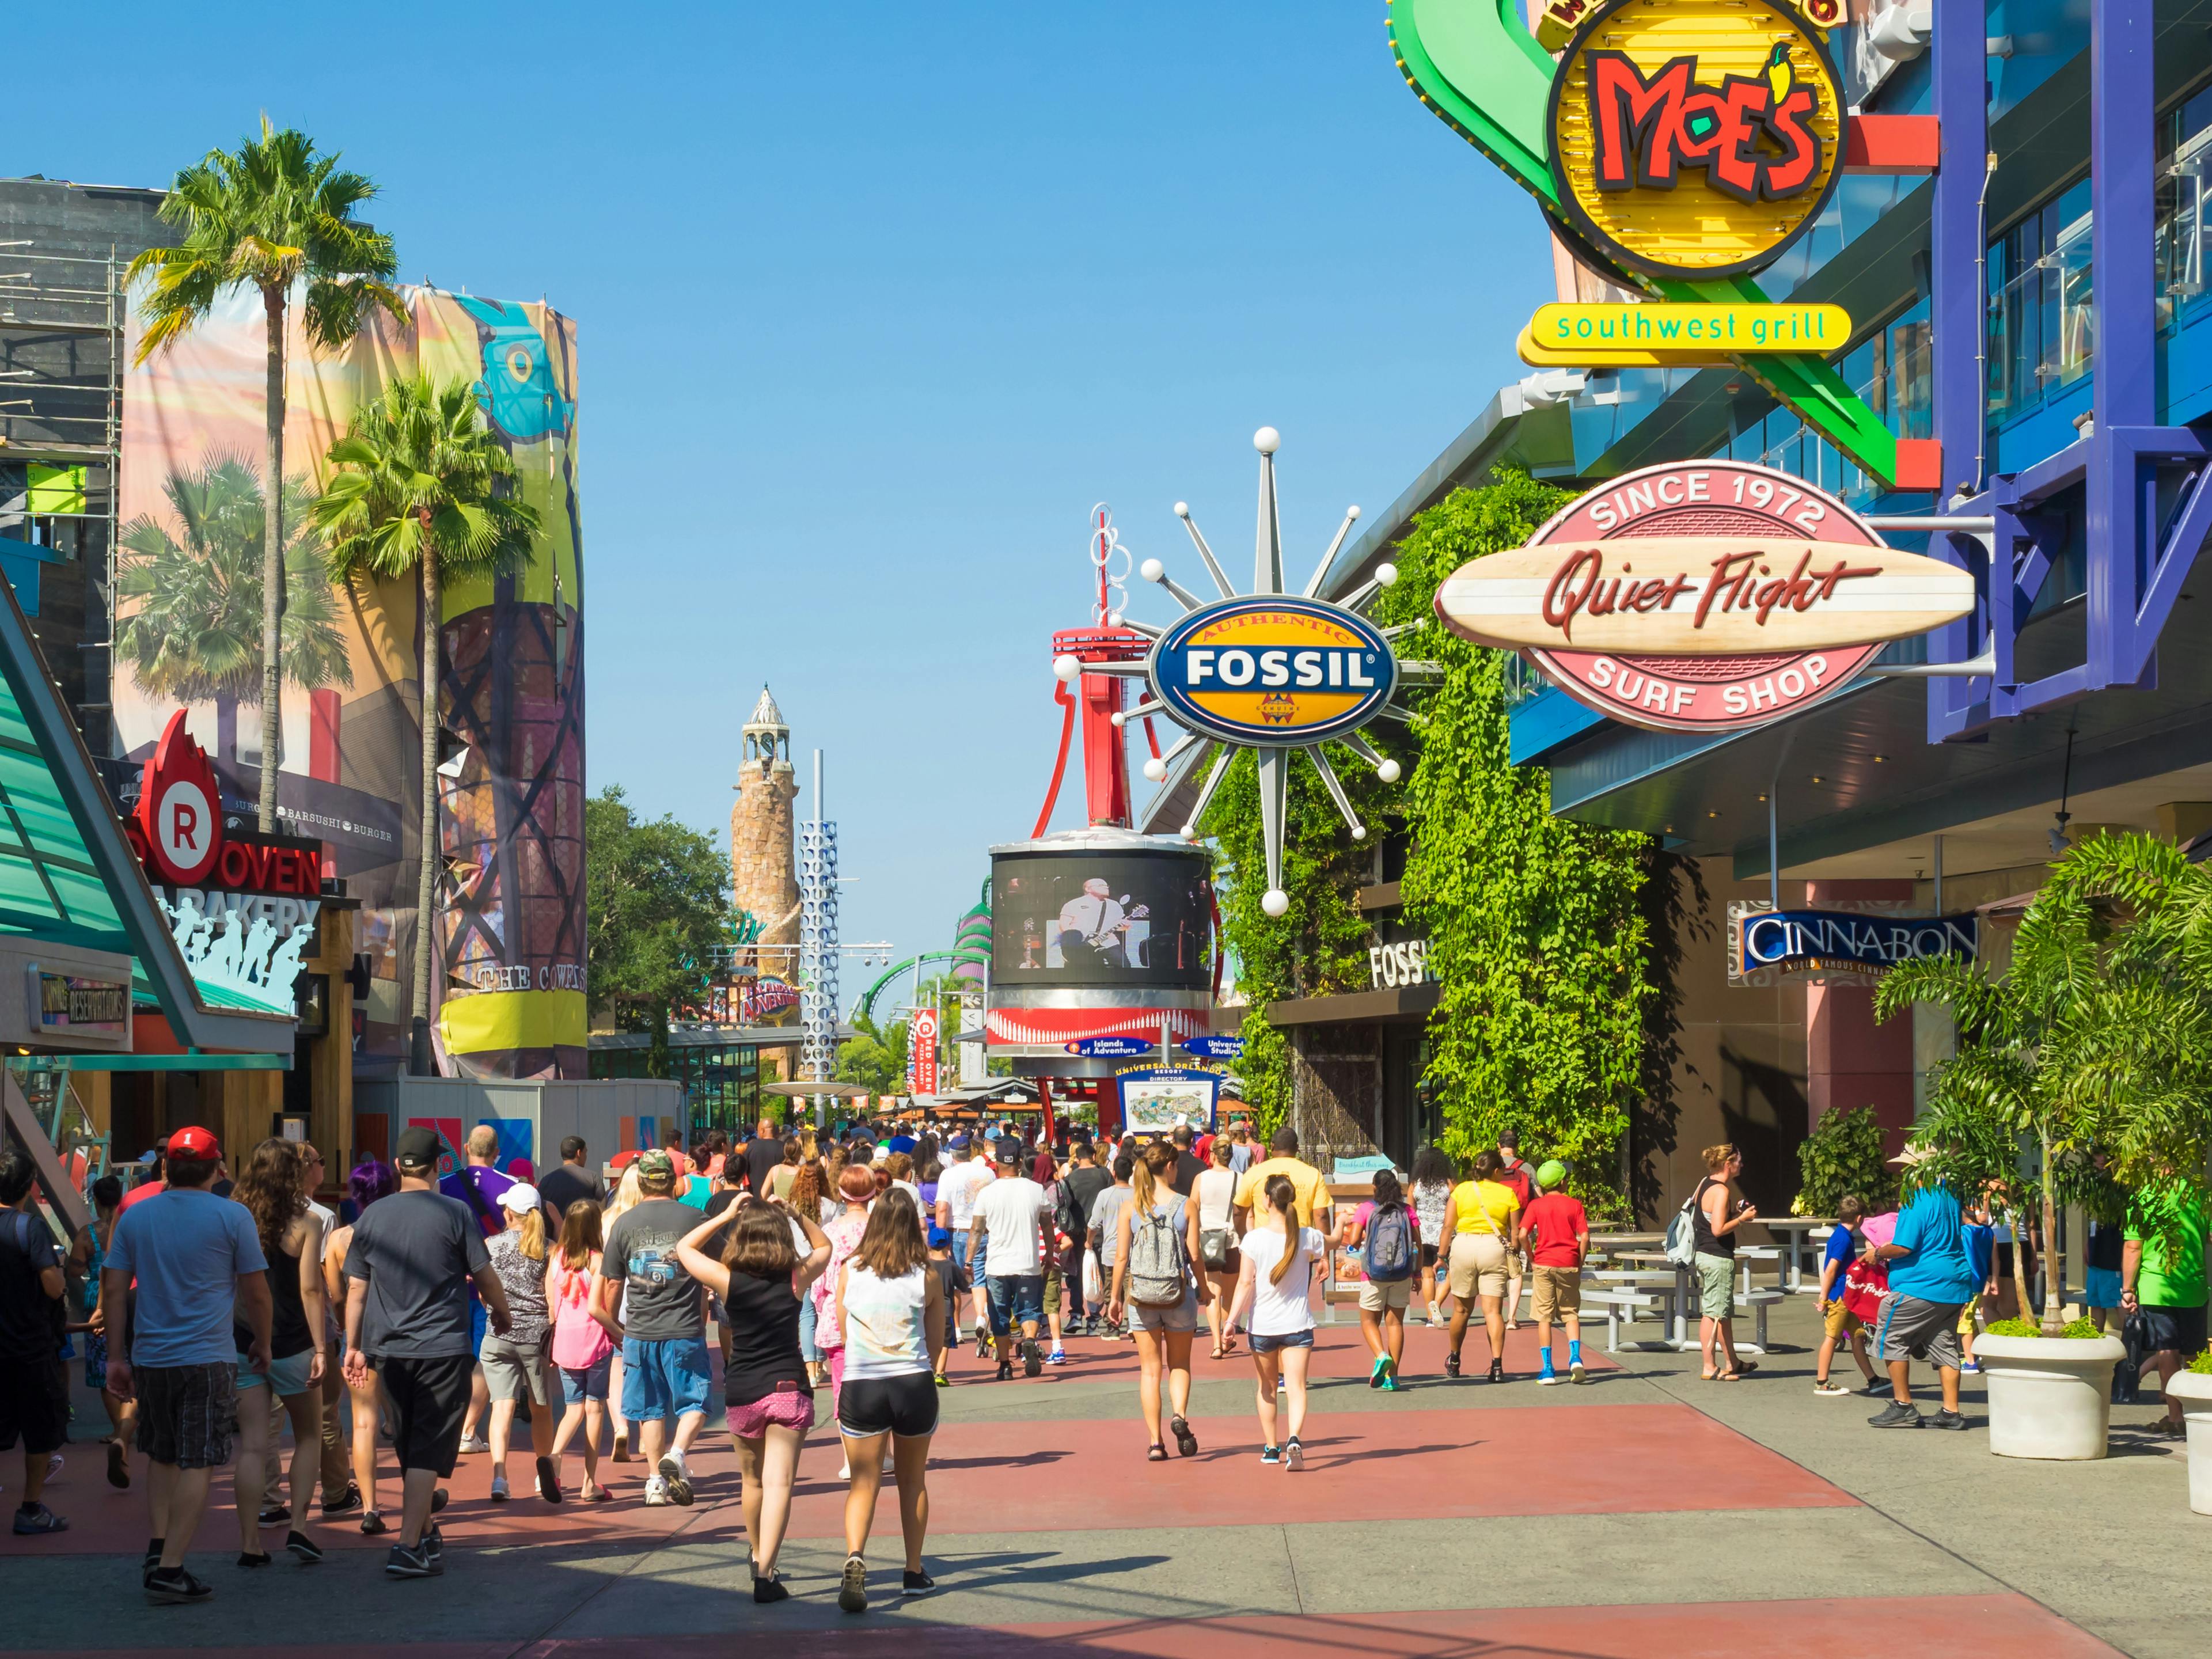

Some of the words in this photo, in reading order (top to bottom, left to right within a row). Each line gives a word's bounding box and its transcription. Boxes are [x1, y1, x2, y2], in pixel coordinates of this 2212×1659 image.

[1557, 313, 1735, 339] southwest
[1752, 313, 1824, 344] grill
[1589, 472, 1710, 532] SINCE
[1732, 474, 1826, 533] 1972
[1542, 548, 1697, 643] Quiet
[1692, 548, 1883, 629] Flight
[1201, 614, 1350, 644] AUTHENTIC
[1187, 650, 1375, 687] FOSSIL
[1587, 656, 1697, 715] SURF
[1722, 655, 1828, 715] SHOP
[288, 808, 340, 829] BARSUSHI
[354, 823, 392, 842] BURGER
[221, 840, 321, 894] OVEN
[175, 887, 321, 939] BAKERY
[1747, 918, 1979, 962] CINNABON
[477, 965, 530, 993] THE
[1786, 959, 1815, 972] WORLD
[1820, 960, 1853, 970] FAMOUS
[1858, 964, 1892, 977] CINNAM
[70, 990, 123, 1021] RESERVATIONS
[1211, 1047, 1240, 1055] Studios
[1116, 1062, 1171, 1076] UNIVERSAL
[1175, 1062, 1221, 1075] ORLANDO
[184, 1133, 192, 1145] 1
